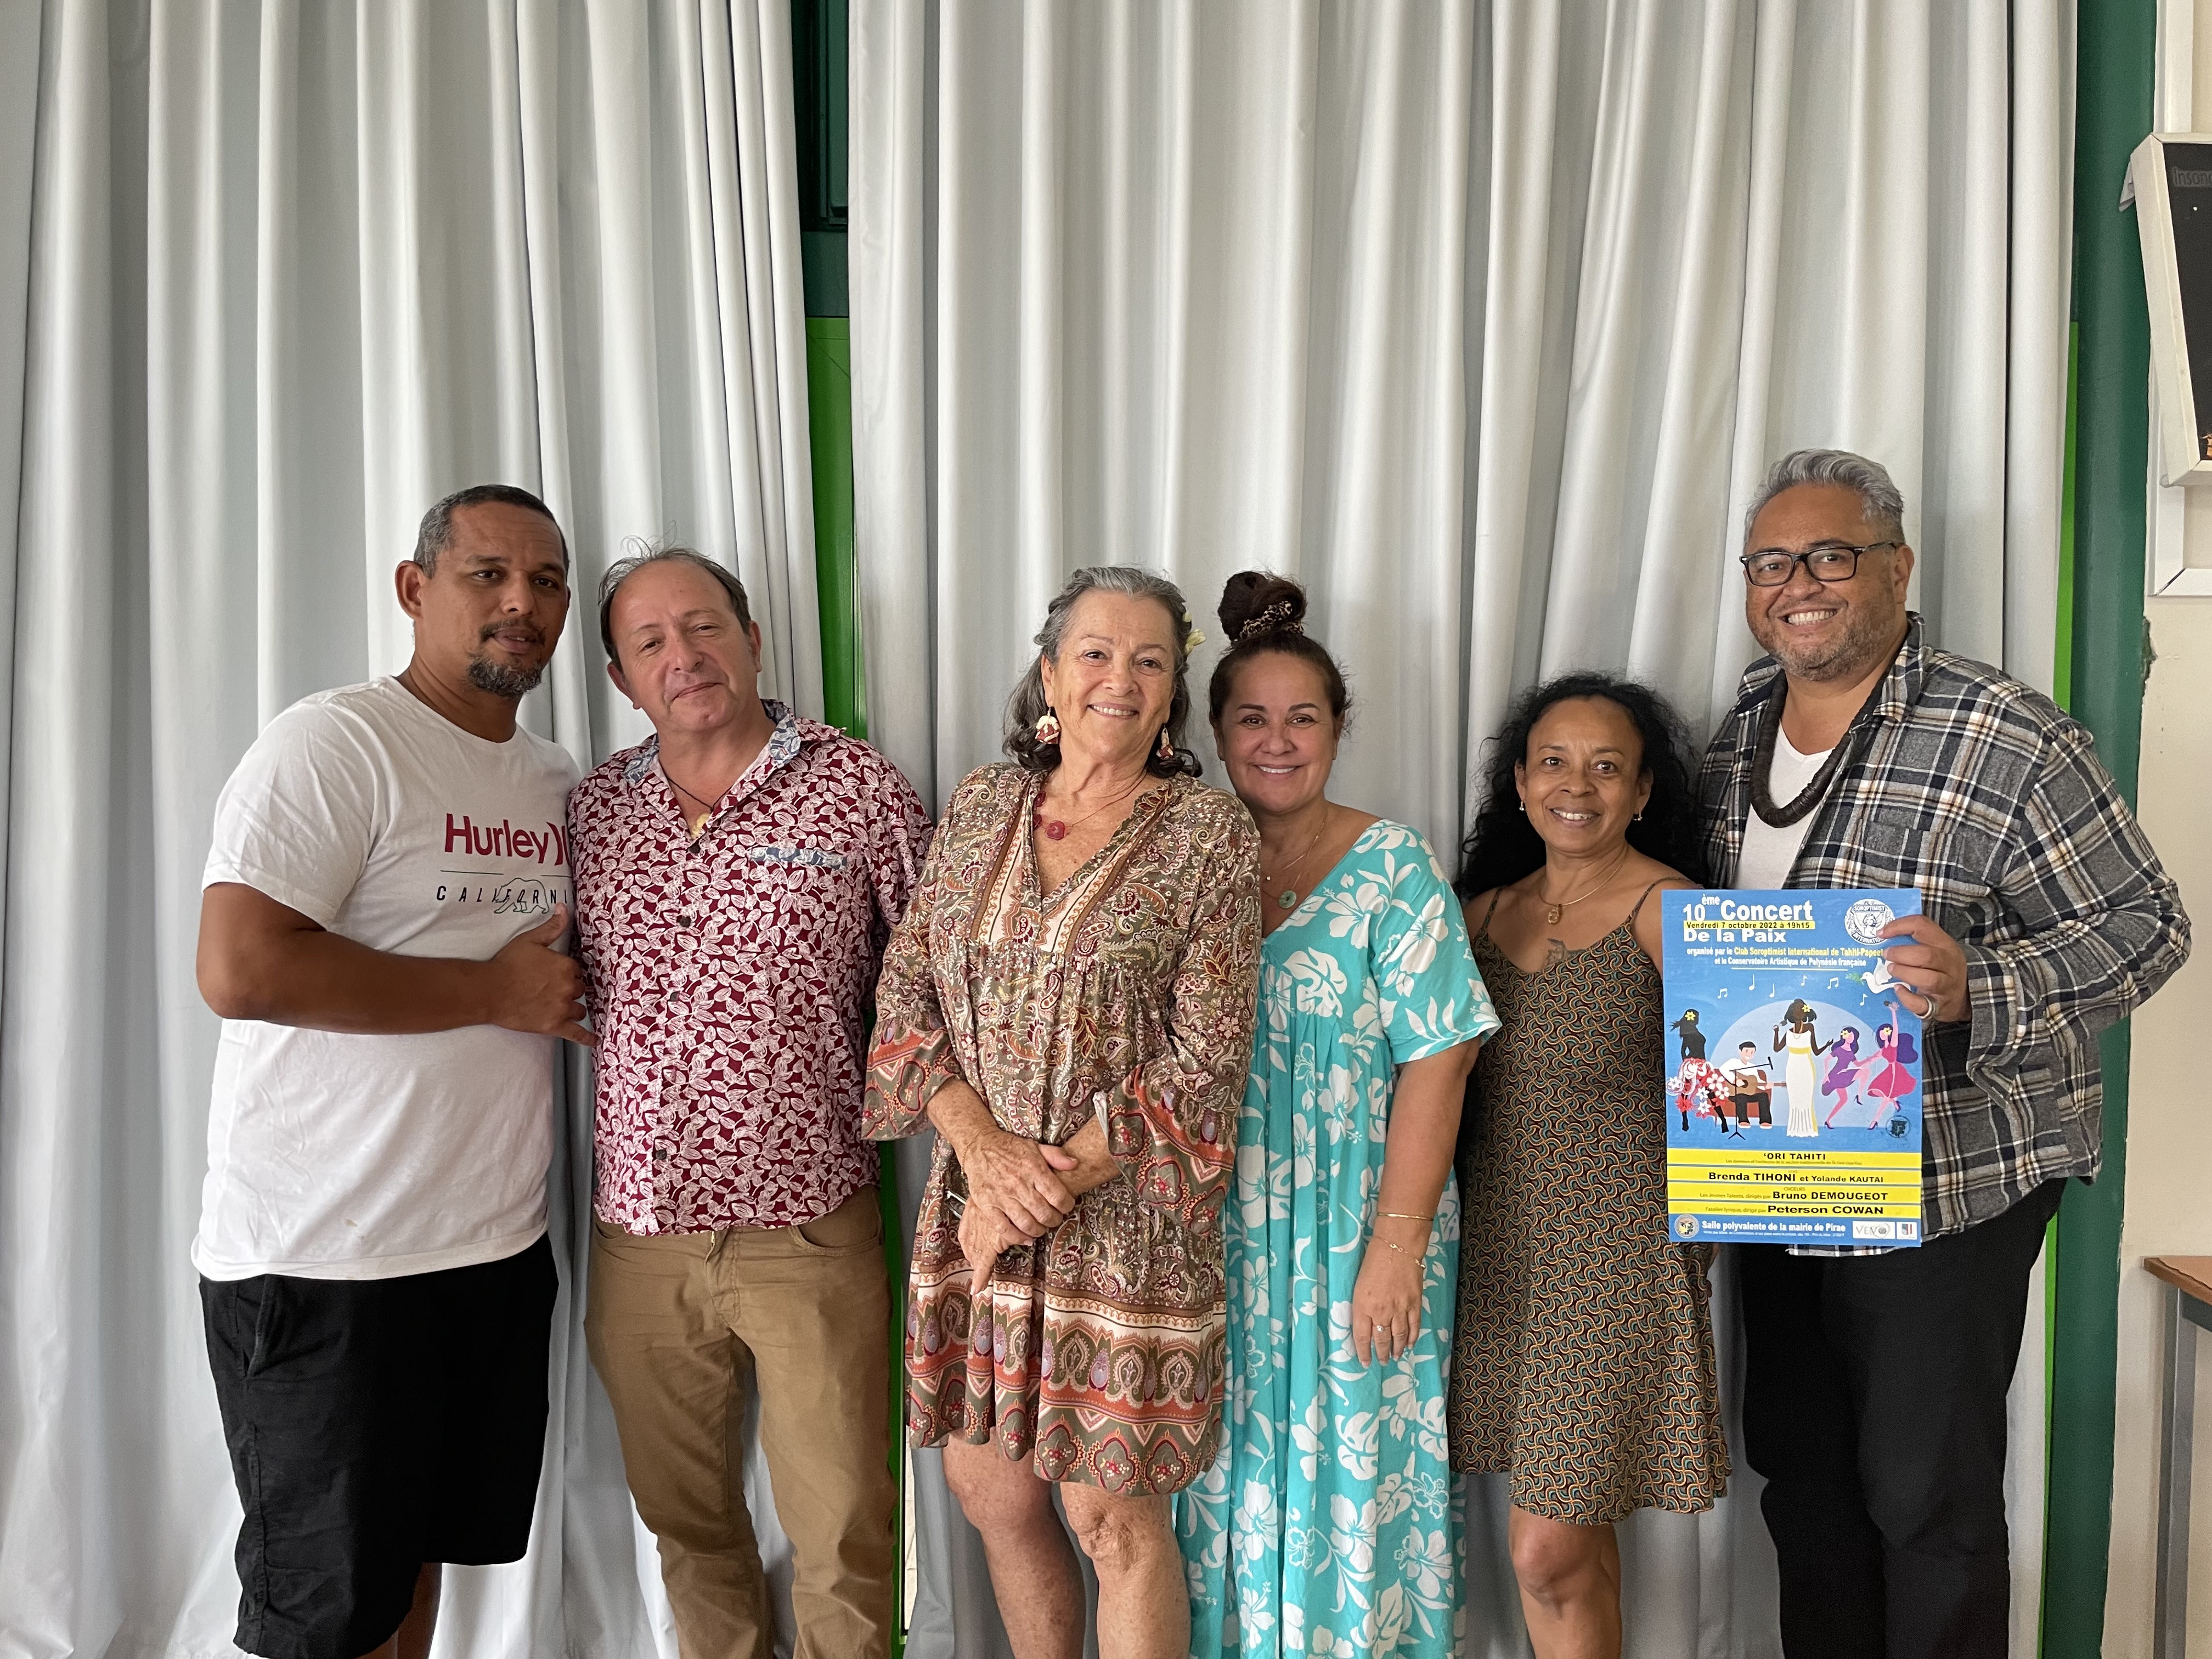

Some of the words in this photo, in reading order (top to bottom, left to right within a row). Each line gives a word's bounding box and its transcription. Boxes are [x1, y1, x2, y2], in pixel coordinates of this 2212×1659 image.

[445, 813, 549, 864] Hurley
[436, 885, 575, 904] CALIFORNI
[1720, 900, 1813, 921] Concert
[1684, 928, 1710, 942] De
[1717, 928, 1734, 942] la
[1742, 929, 1786, 943] Paix
[1686, 947, 1713, 957] organisé
[1715, 948, 1725, 957] par
[1734, 947, 1748, 955] Club
[1750, 947, 1786, 957] Soroptimist
[1788, 947, 1829, 956] International
[1728, 957, 1768, 965] Conservatoire
[1769, 957, 1798, 967] Artistique
[1809, 957, 1837, 967] Polynésie
[1838, 958, 1866, 968] française
[1754, 1173, 1796, 1181] TIHONI
[1773, 1191, 1807, 1199] Bruno
[1811, 1192, 1888, 1200] DEMOUGEOT
[1768, 1205, 1828, 1214] Peterson
[1832, 1206, 1883, 1214] COWAN
[1702, 1221, 1721, 1229] Salle
[1723, 1221, 1766, 1232] polyvalente
[1768, 1222, 1778, 1231] de
[1779, 1223, 1787, 1231] la
[1788, 1223, 1812, 1231] mairie
[1814, 1223, 1824, 1231] de
[1826, 1223, 1846, 1232] Pirae
